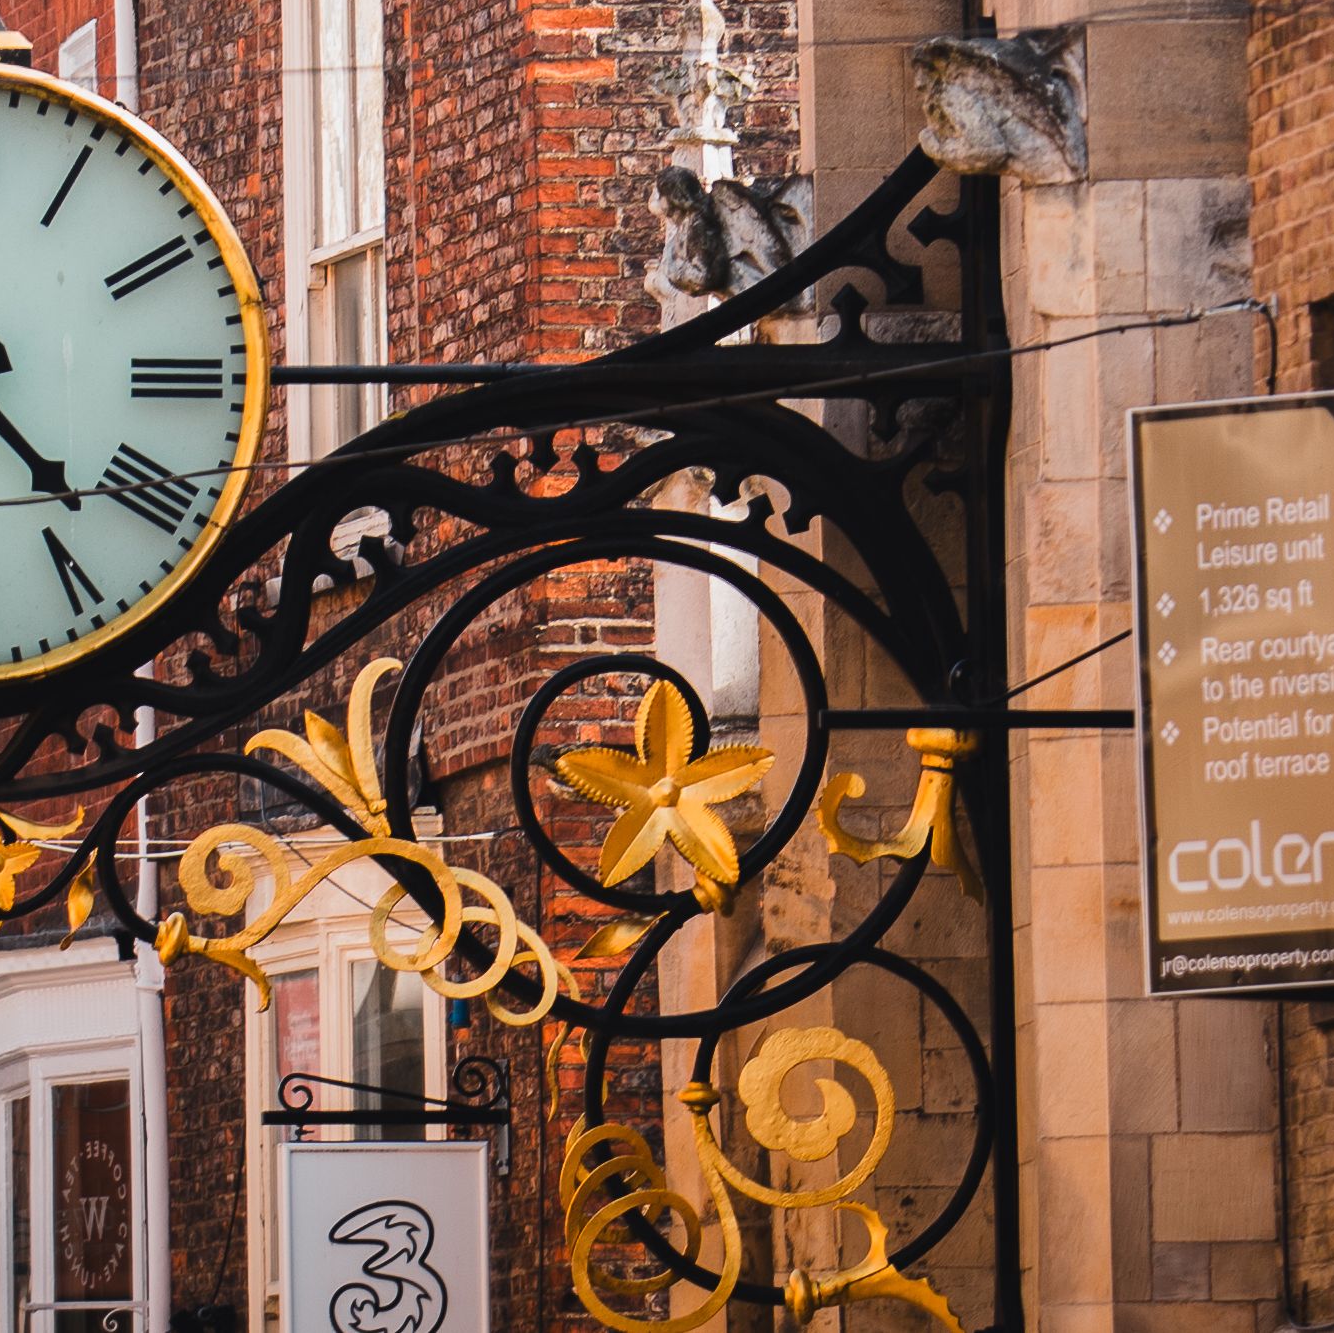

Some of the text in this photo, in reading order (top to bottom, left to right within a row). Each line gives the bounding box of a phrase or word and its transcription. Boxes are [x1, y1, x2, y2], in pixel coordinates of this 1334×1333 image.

[40, 144, 93, 227] I
[103, 235, 194, 301] II
[130, 357, 223, 398] III
[1196, 502, 1260, 531] Prime
[1267, 494, 1330, 525] Retail
[1197, 533, 1325, 570] Leisure unit
[41, 526, 105, 616] V
[1199, 579, 1314, 616] 1,326 sq ft
[1201, 637, 1255, 664] Rear
[1202, 677, 1224, 702] to
[1229, 673, 1264, 700] the
[1204, 712, 1298, 744] Potential
[1304, 708, 1333, 736] for
[1205, 751, 1331, 781] roof terrace
[79, 1196, 110, 1242] W
